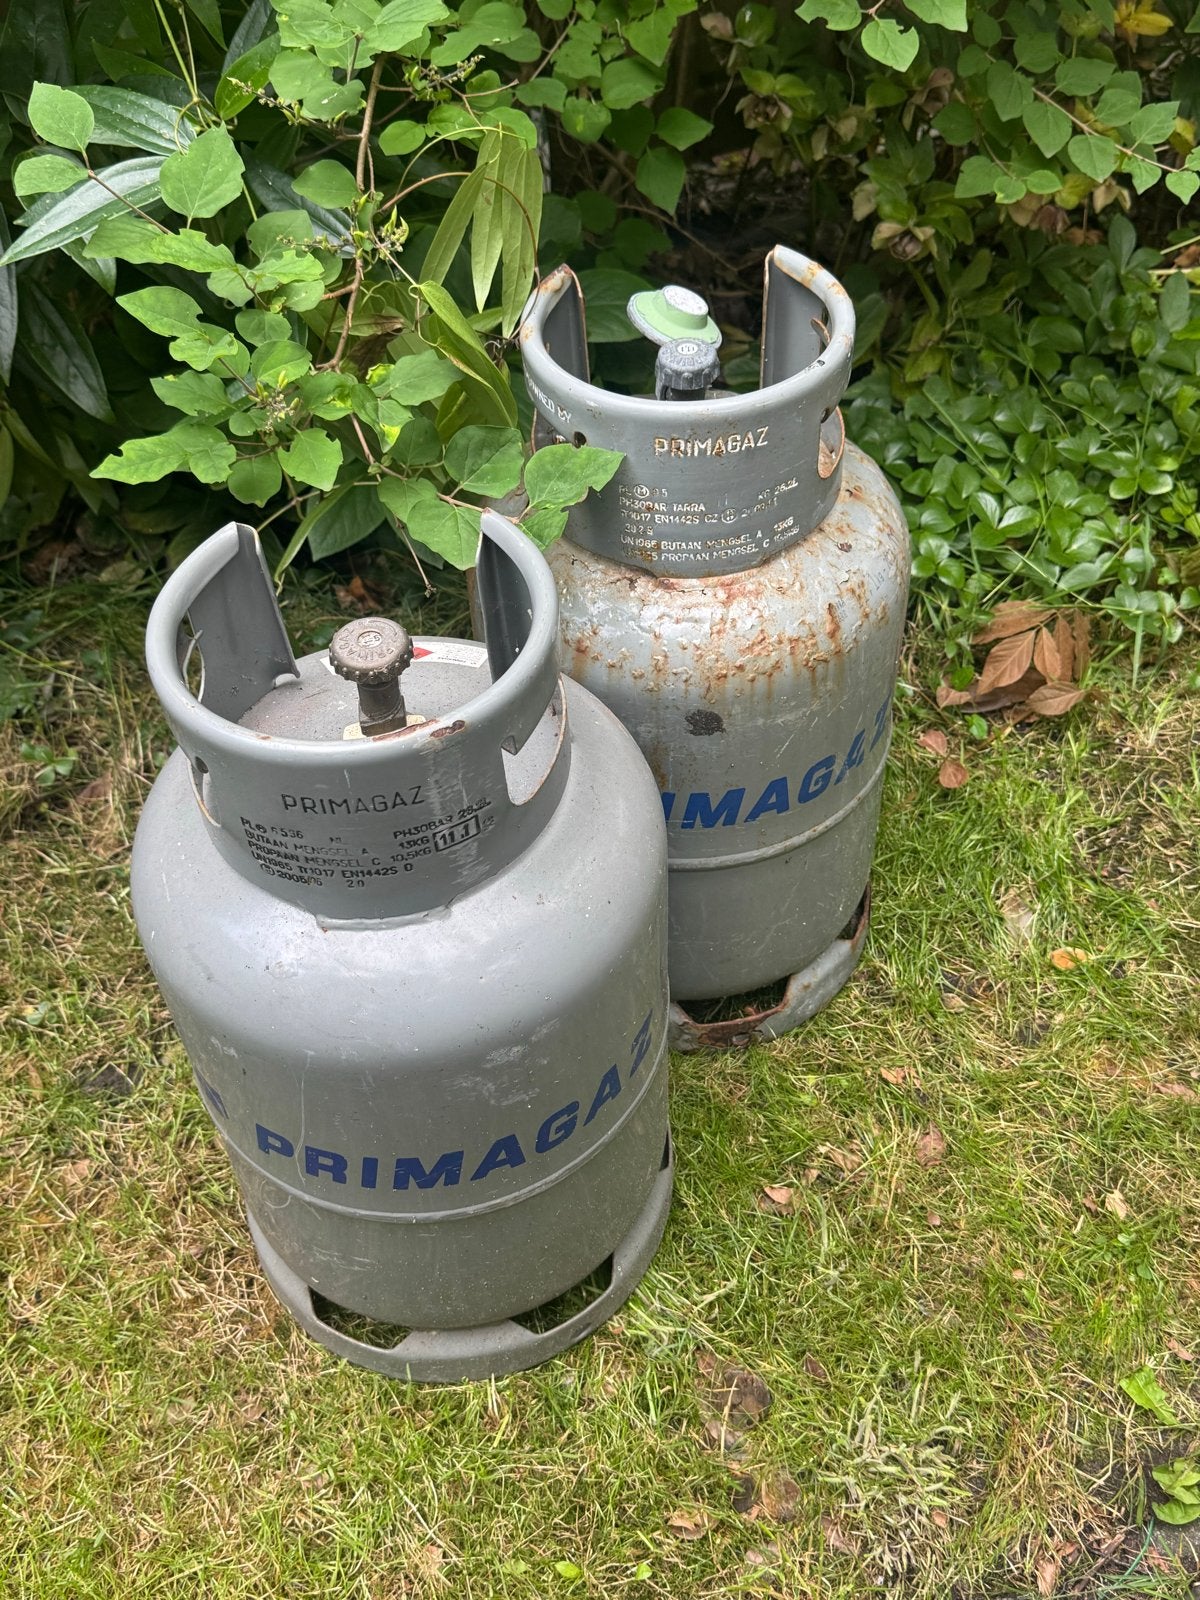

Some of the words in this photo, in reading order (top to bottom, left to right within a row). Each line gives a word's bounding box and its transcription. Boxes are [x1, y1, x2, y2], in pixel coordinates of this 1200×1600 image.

[654, 425, 769, 457] PRIMAGAZ
[672, 503, 706, 512] TARRA
[660, 541, 702, 550] BUTAAN
[712, 543, 760, 559] MENGSEL
[280, 785, 425, 815] PRIMAGAZ
[244, 828, 289, 850] BUTAAN
[439, 823, 470, 846] 11.1
[247, 839, 300, 862] PROPAAN
[371, 857, 381, 866] C
[341, 866, 398, 878] EN1442S
[255, 1009, 653, 1190] PRIMAGAZ
